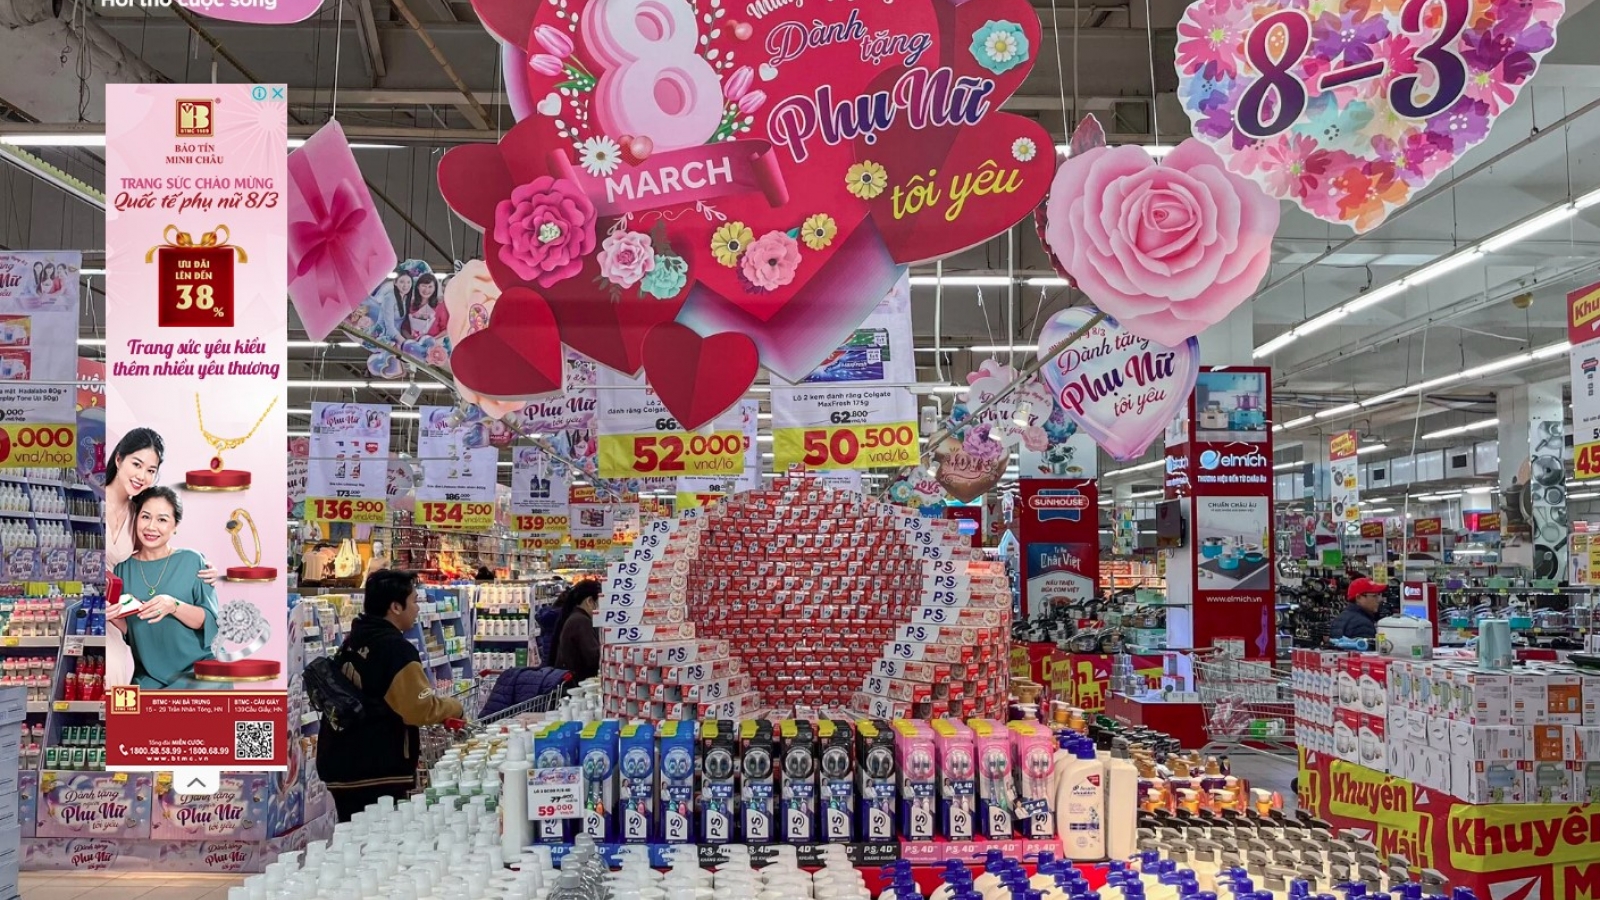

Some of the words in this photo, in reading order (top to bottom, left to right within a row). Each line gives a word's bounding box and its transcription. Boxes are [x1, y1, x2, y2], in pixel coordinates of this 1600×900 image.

[765, 9, 866, 67] Dành
[860, 27, 932, 66] tặng
[766, 85, 897, 164] Phụ
[895, 65, 997, 131] Nữ
[604, 155, 735, 204] MARCH
[890, 173, 943, 222] tôi
[945, 159, 1026, 222] yêu
[1057, 337, 1113, 377] Dành
[863, 390, 891, 399] Colgate
[1060, 367, 1124, 417] Phụ
[1124, 350, 1175, 388] Nữ
[524, 403, 563, 421] Phụ
[566, 397, 597, 413] Nữ
[1113, 392, 1135, 418] tôi
[1138, 387, 1167, 416] yêu
[632, 434, 741, 473] 52.000
[802, 425, 914, 466] 50.500
[868, 447, 909, 463] vnd/lô
[314, 500, 384, 521] 136.900
[422, 502, 492, 524] 134.500
[1034, 498, 1084, 507] SUNHOUSE
[516, 515, 567, 531] 139.000
[64, 789, 96, 803] Dành
[1333, 773, 1407, 815] Khuyến
[61, 803, 96, 826] Phụ
[98, 800, 128, 820] Nữ
[176, 805, 211, 827] Phụ
[214, 803, 244, 822] Nữ
